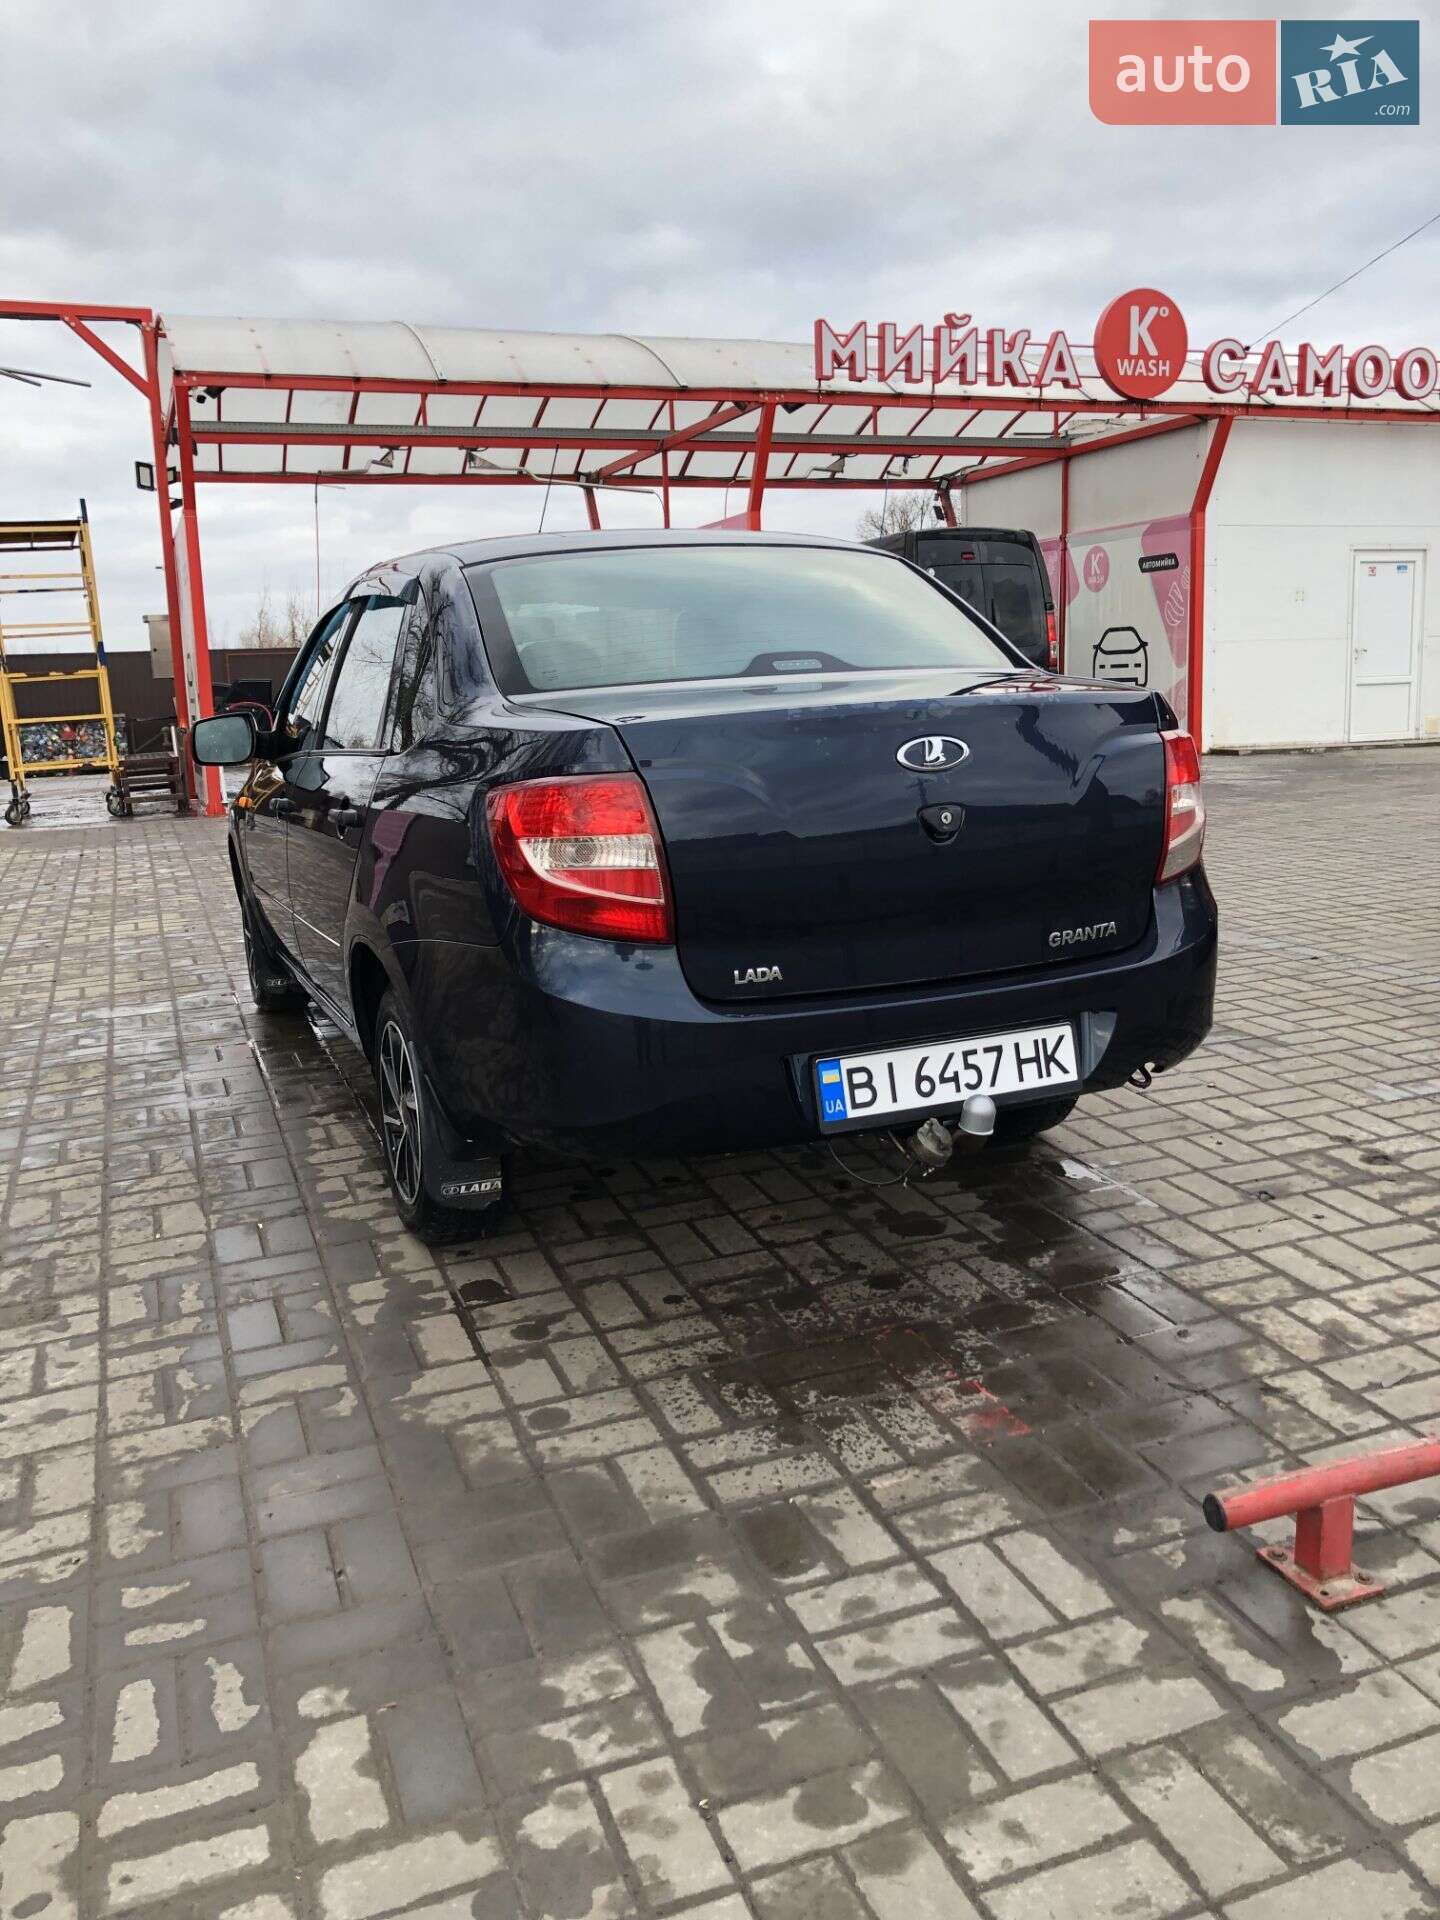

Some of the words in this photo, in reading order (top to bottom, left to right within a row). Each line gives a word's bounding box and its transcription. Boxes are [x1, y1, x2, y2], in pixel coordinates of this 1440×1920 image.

[814, 312, 1082, 389] МИЙКА
[1201, 338, 1438, 401] САМОО
[1116, 358, 1170, 377] WASH
[1048, 921, 1118, 948] GRANTA
[733, 965, 783, 985] LADA
[914, 1045, 1003, 1098] 6457
[1013, 1034, 1071, 1083] HK
[825, 1098, 845, 1114] UA
[460, 1180, 502, 1194] LADA
